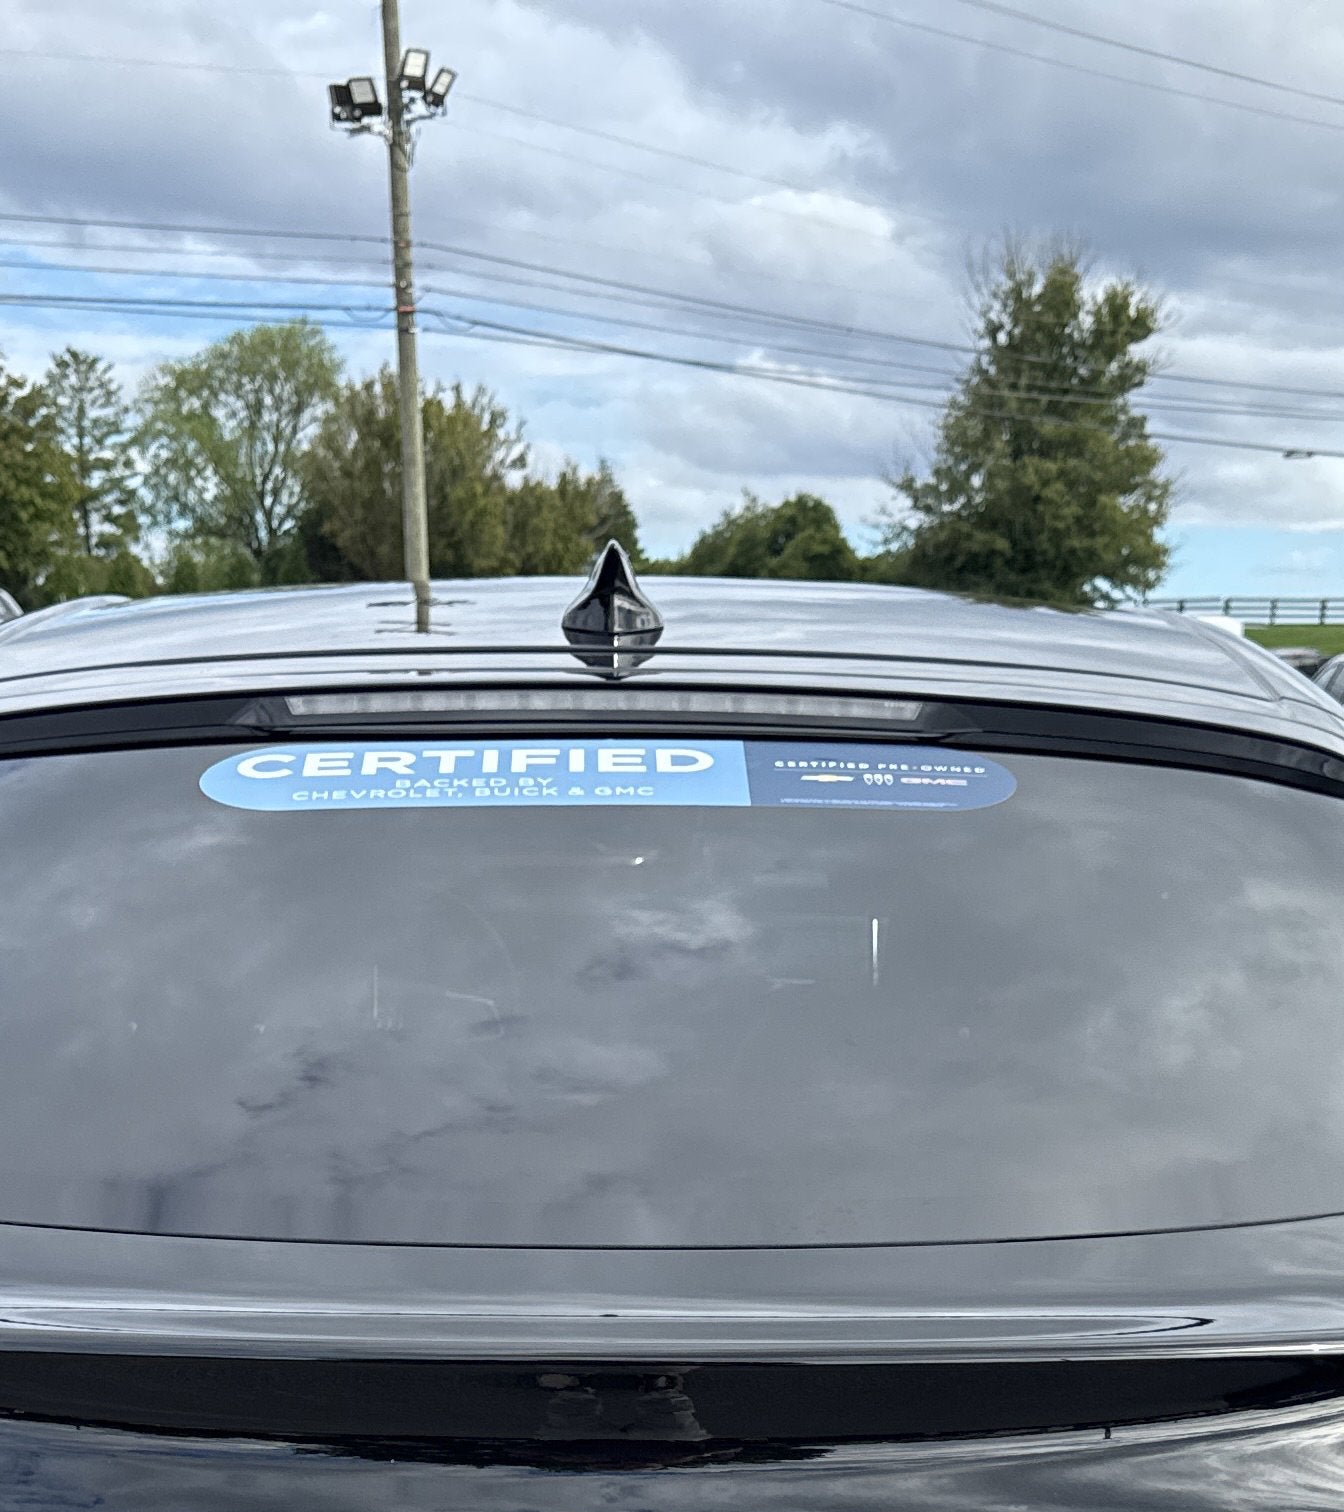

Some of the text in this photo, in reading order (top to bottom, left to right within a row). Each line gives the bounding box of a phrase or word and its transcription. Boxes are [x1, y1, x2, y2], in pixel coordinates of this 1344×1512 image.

[236, 748, 715, 779] CERTIFIED
[774, 760, 870, 770] CERTIFIED
[395, 776, 554, 789] BACKED BY
[291, 785, 655, 801] CHEVROLET, BUICK & GMC
